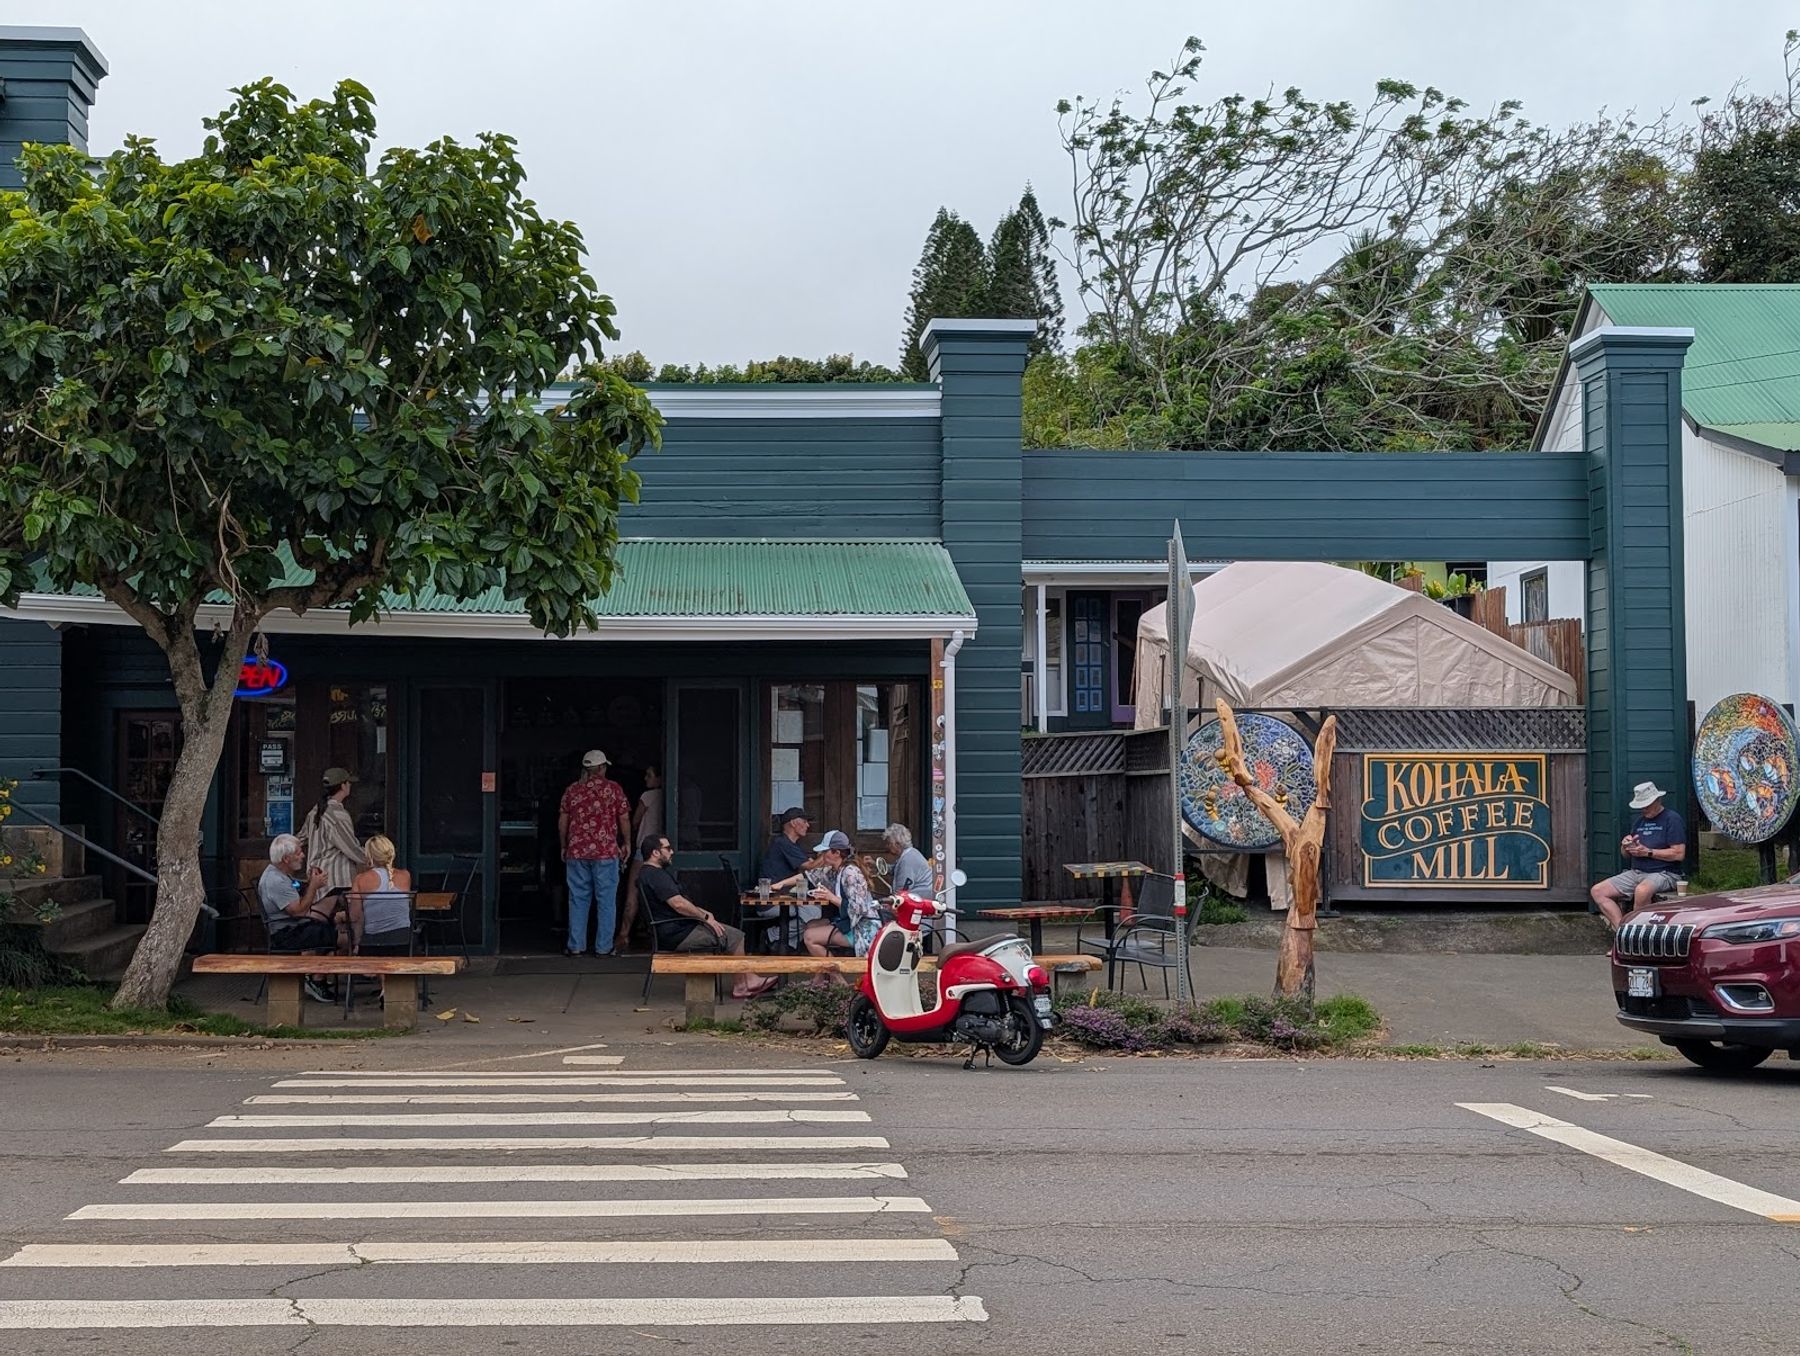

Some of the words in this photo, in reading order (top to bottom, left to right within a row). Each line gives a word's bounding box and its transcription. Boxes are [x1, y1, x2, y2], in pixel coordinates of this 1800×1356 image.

[239, 664, 281, 689] PEN
[1384, 762, 1529, 815] KOHALA
[1378, 801, 1535, 850] COFFEE
[1411, 836, 1509, 879] MILL
